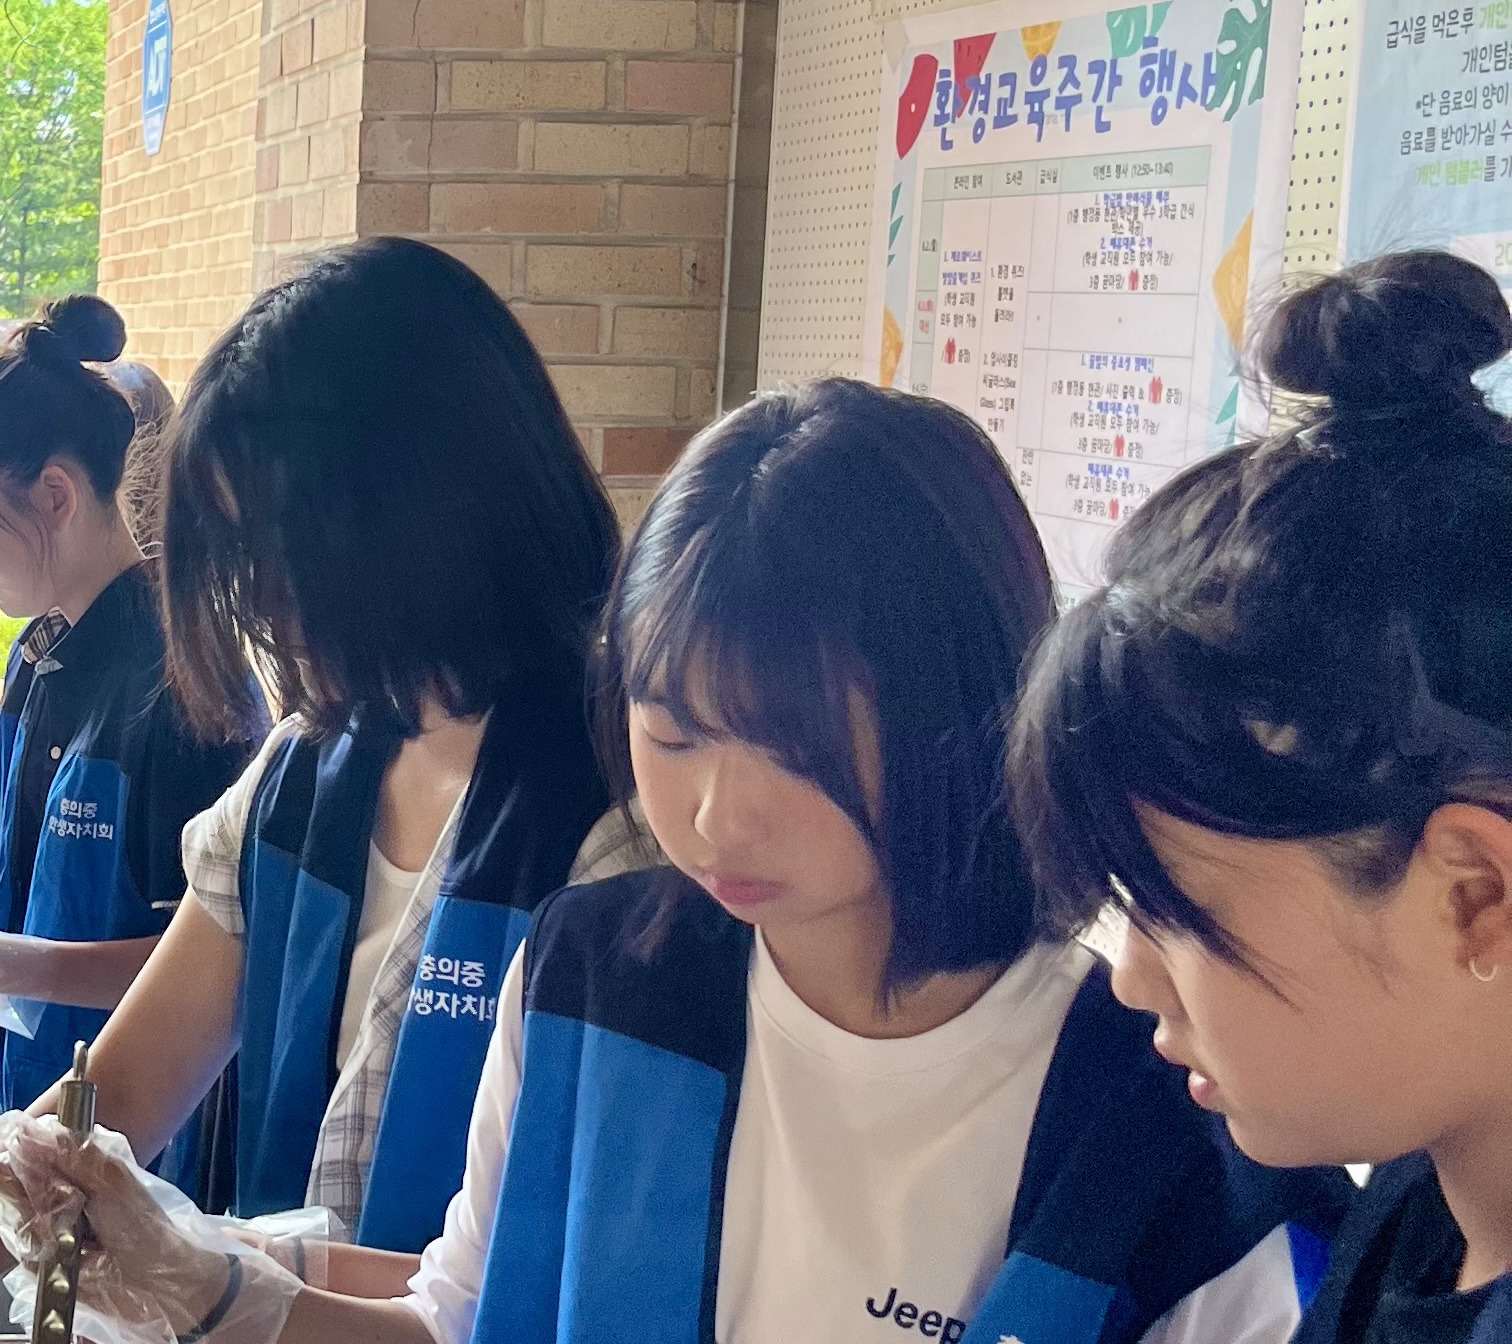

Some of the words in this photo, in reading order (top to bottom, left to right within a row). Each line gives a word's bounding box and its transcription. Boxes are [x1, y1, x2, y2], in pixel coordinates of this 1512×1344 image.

[1386, 16, 1427, 49] 급식을
[1432, 7, 1474, 39] 먹은후
[1479, 0, 1512, 30] 개인
[933, 53, 1123, 151] 환경교육주간
[1138, 36, 1221, 127] 행사
[1439, 86, 1478, 116] 음료의
[1482, 82, 1510, 110] 양이
[1400, 126, 1436, 155] 음료를
[1441, 119, 1497, 151] 받아가실
[1040, 168, 1059, 184] 급식실
[1092, 164, 1112, 181] 이벤트
[1115, 162, 1129, 179] 행사
[60, 797, 98, 819] 충의중
[48, 815, 114, 840] 학생자치회
[419, 953, 486, 988] 충의중
[407, 987, 497, 1022] 생자치
